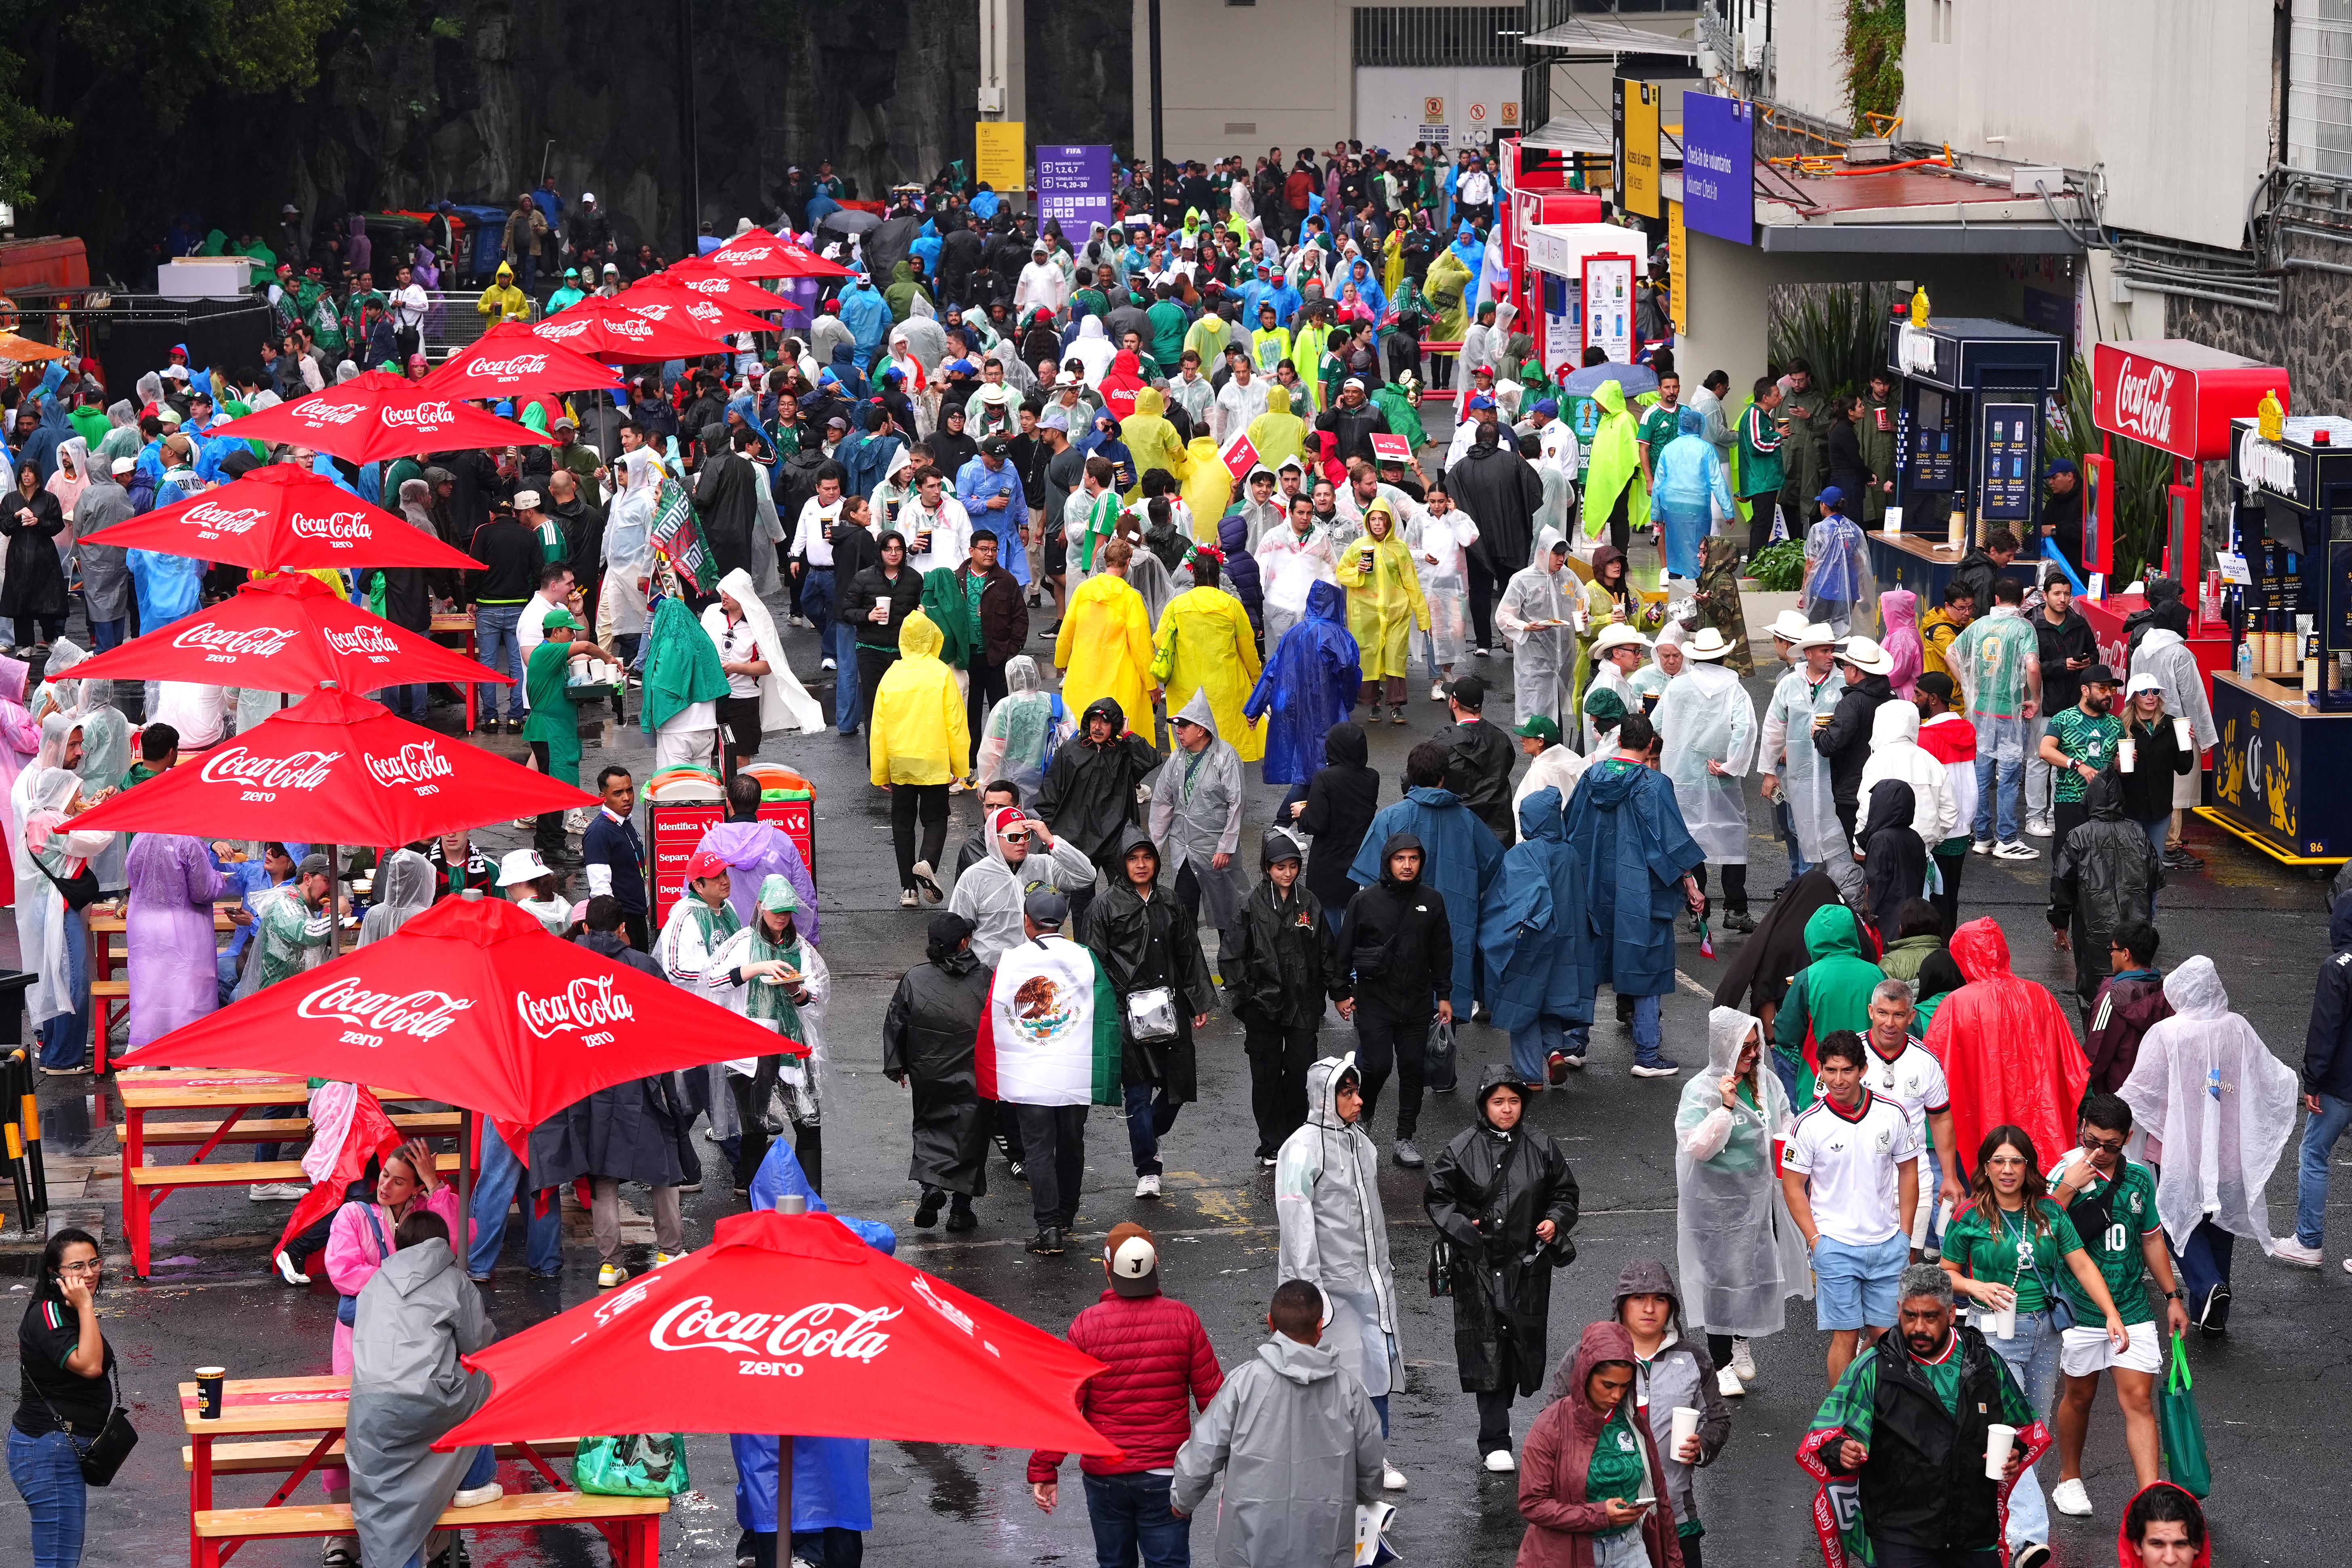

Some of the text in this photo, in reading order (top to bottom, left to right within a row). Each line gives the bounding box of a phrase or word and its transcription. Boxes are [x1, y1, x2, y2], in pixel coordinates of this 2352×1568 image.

[1615, 137, 1621, 193] 8
[1627, 148, 1651, 171] Acceso al campo
[1687, 144, 1731, 173] Check-In de voluntarios
[1687, 174, 1717, 200] Volunteer Check-In
[713, 246, 774, 263] Coca-Cola
[686, 301, 722, 320] Coca-Cola
[532, 319, 594, 338] Coca-Cola
[603, 318, 654, 336] Coca-Cola
[466, 353, 550, 377] Coca-Cola
[291, 398, 369, 425] Coca-Cola
[2096, 356, 2176, 445] 11 Coca-Cola
[381, 400, 455, 427] Coca-Cola
[180, 502, 270, 536] Coca-Cola
[291, 512, 373, 540] Coca-Cola
[197, 531, 219, 540] zero
[172, 622, 301, 658] Coca-Cola
[324, 625, 400, 655] Coca-Cola
[204, 654, 237, 663] zero
[367, 655, 390, 663] zero
[1982, 636, 2002, 677] 9
[200, 746, 346, 792] Coca-Cola
[364, 738, 454, 788] Coca-Cola
[240, 791, 276, 802] zero
[413, 784, 440, 796] zero
[658, 822, 698, 831] Identifica
[659, 854, 689, 862] Separa
[2310, 842, 2323, 852] 86
[297, 977, 477, 1043] Coca-Cola
[517, 973, 635, 1039] Coca-Cola
[339, 1031, 383, 1047] zero
[580, 1031, 615, 1047] zero
[187, 1077, 285, 1086] Coca-Cola
[2105, 1223, 2126, 1251] 10
[1131, 1258, 1143, 1273] J
[649, 1296, 904, 1364] Coca-Cola
[738, 1360, 804, 1377] zero
[268, 1389, 350, 1402] Coca-C
